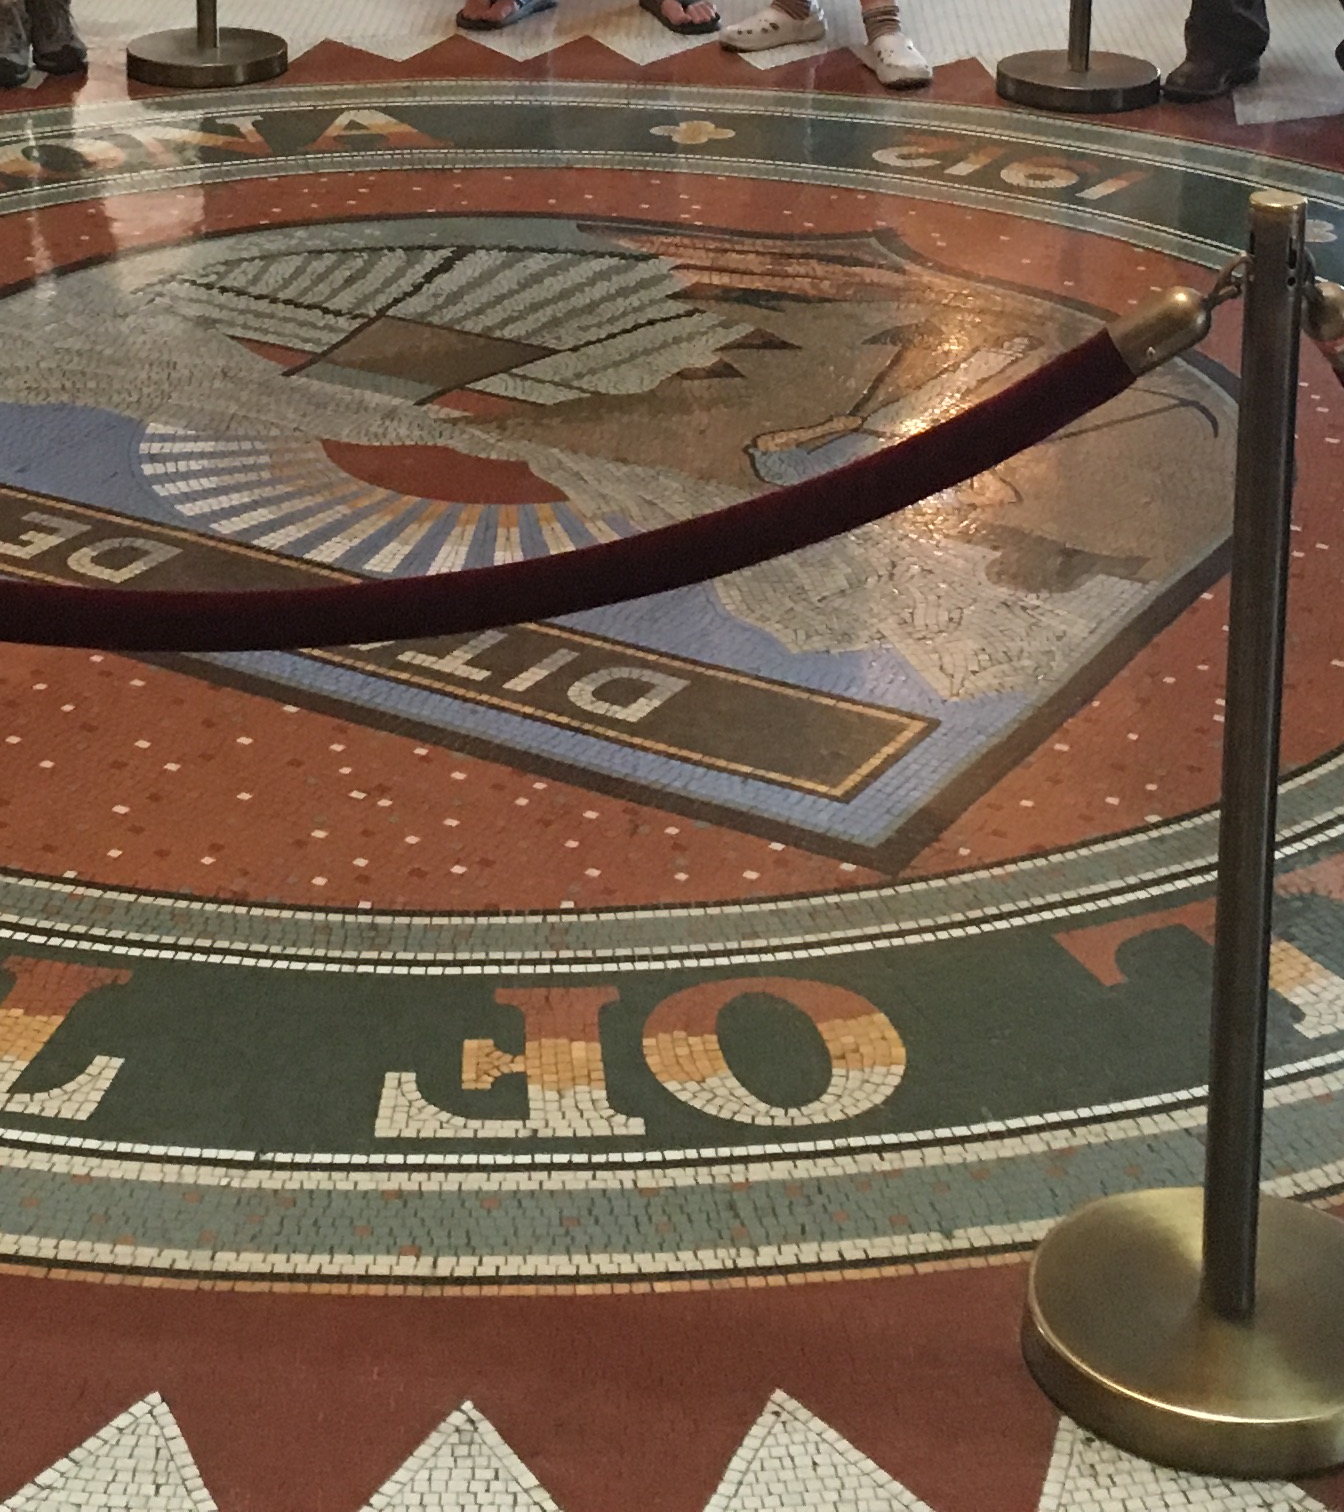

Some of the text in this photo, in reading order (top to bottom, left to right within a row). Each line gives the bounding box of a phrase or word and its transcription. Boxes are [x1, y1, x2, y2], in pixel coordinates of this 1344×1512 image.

[870, 133, 1151, 201] 1912
[350, 628, 692, 725] DIT
[374, 975, 907, 1140] OF
